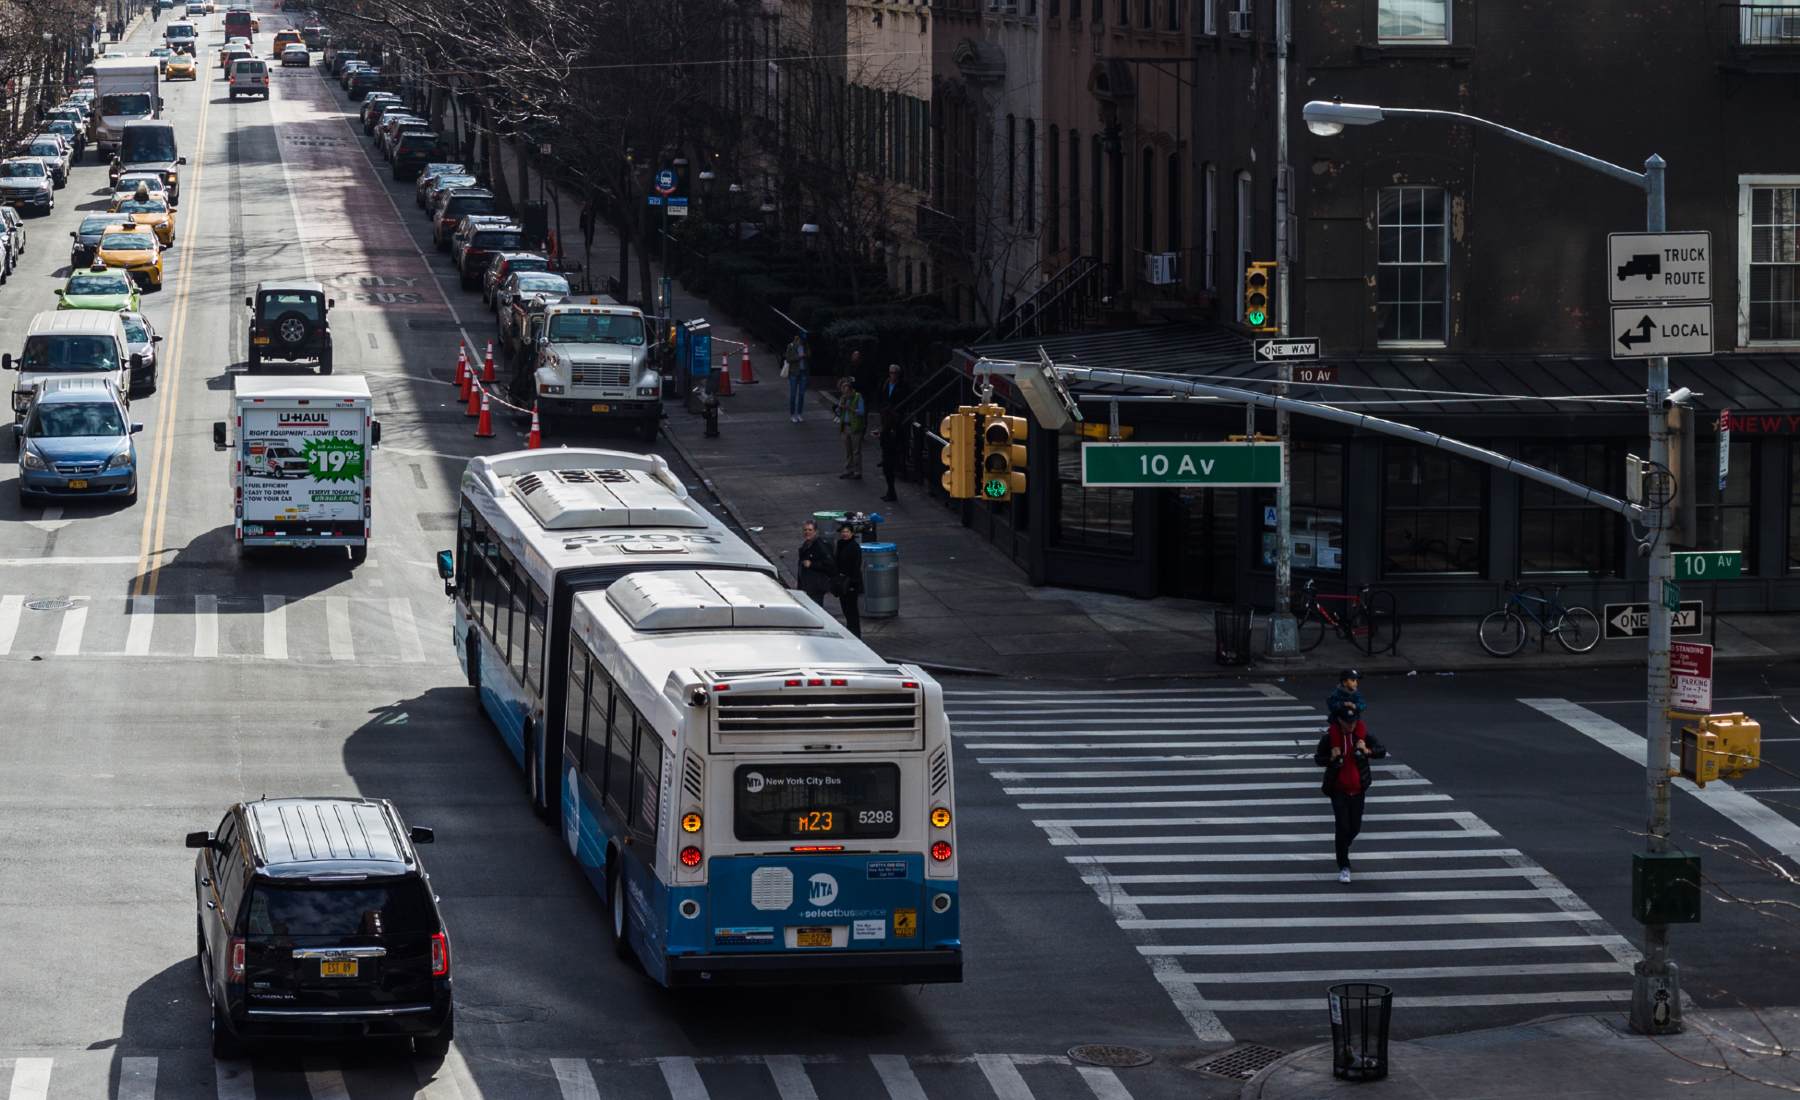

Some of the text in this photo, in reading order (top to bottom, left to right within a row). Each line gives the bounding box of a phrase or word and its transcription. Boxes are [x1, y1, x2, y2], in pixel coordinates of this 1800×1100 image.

[1664, 248, 1705, 262] TRUCK
[1664, 271, 1706, 285] ROUTE
[1662, 323, 1709, 338] LOCAL
[1264, 344, 1312, 355] ONE WAY
[1300, 370, 1313, 381] 10
[1730, 416, 1781, 432] NEW
[1140, 454, 1215, 475] 10 Av
[1266, 509, 1275, 520] A
[1685, 556, 1706, 575] 10
[1620, 613, 1690, 628] ONE AY
[1676, 645, 1704, 654] STANDING
[1682, 678, 1708, 687] PARKING
[786, 777, 804, 785] York
[806, 777, 823, 785] City
[825, 777, 841, 785] Bus
[799, 812, 832, 831] M23
[859, 811, 893, 824] 5298
[809, 881, 833, 898] MTA
